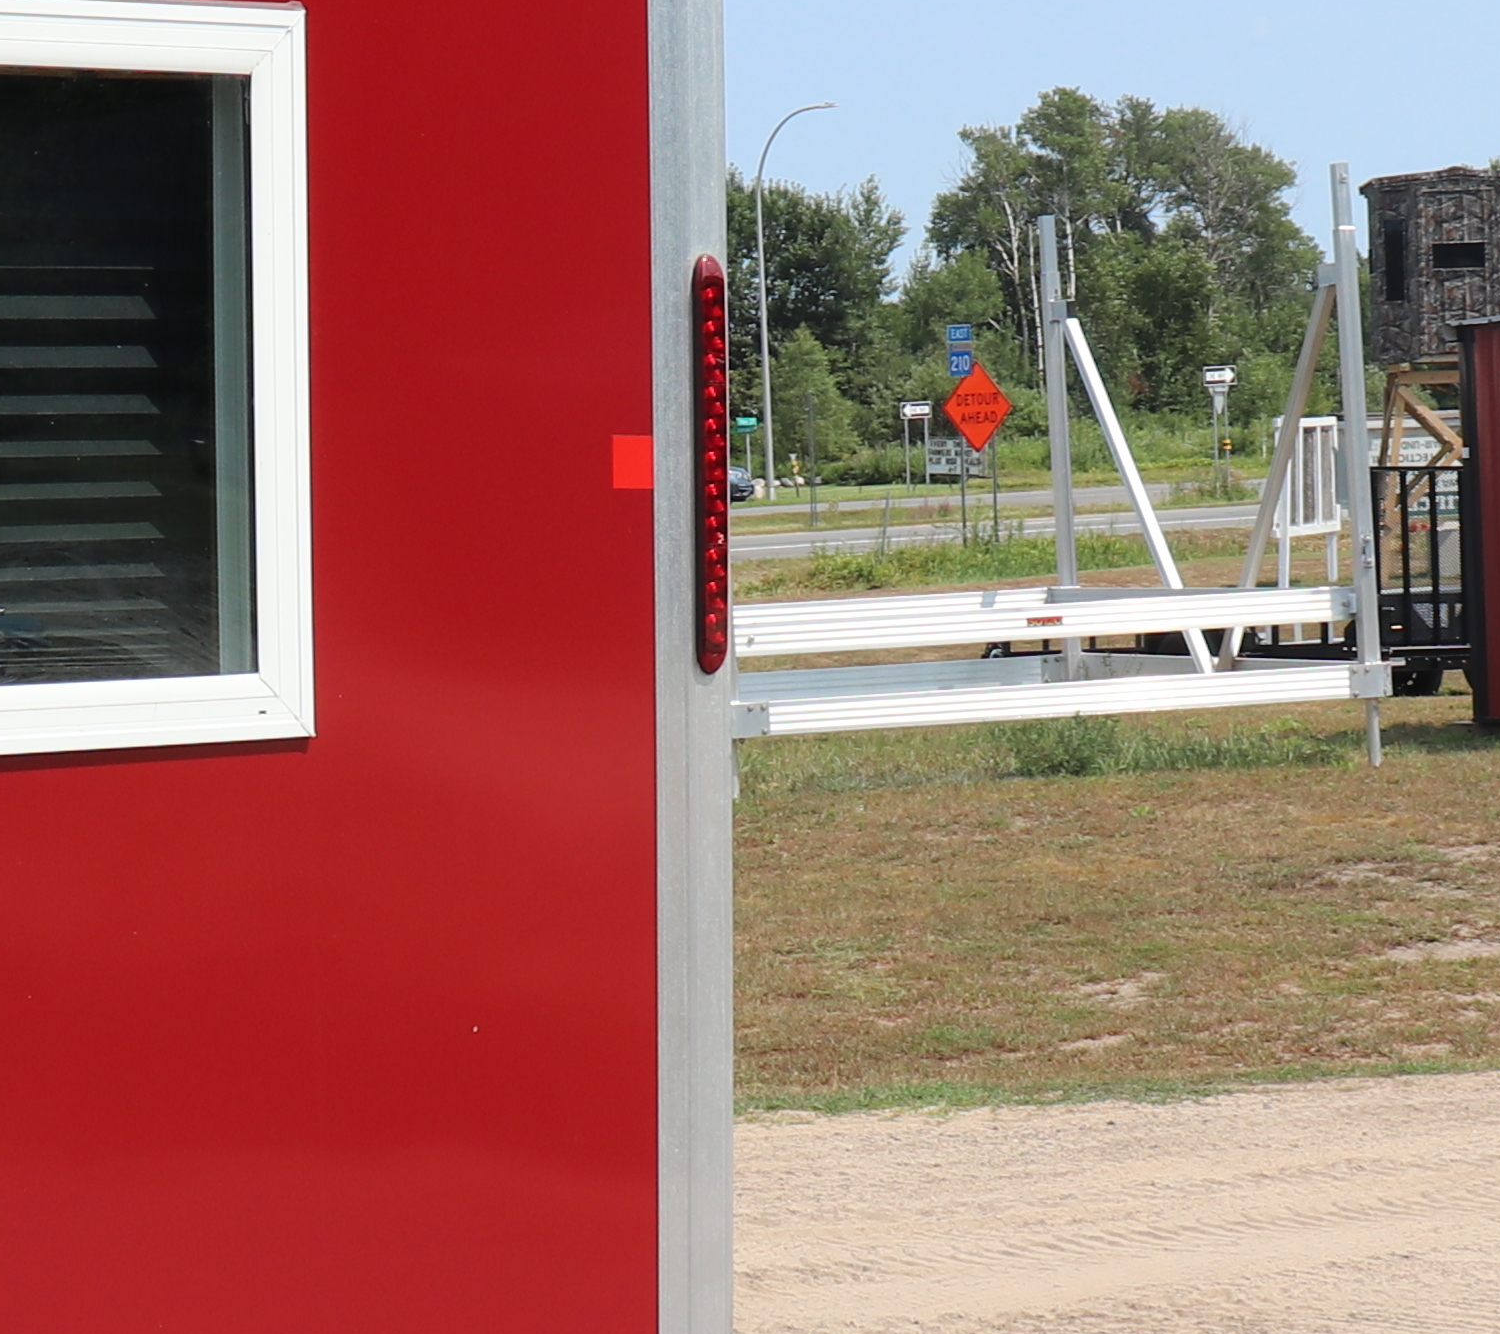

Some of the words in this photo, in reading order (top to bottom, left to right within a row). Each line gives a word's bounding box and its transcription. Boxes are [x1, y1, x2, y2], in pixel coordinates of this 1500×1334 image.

[950, 329, 969, 339] EAST
[950, 355, 971, 372] 210
[956, 392, 999, 406] DETOUR
[960, 411, 998, 424] AHEAD
